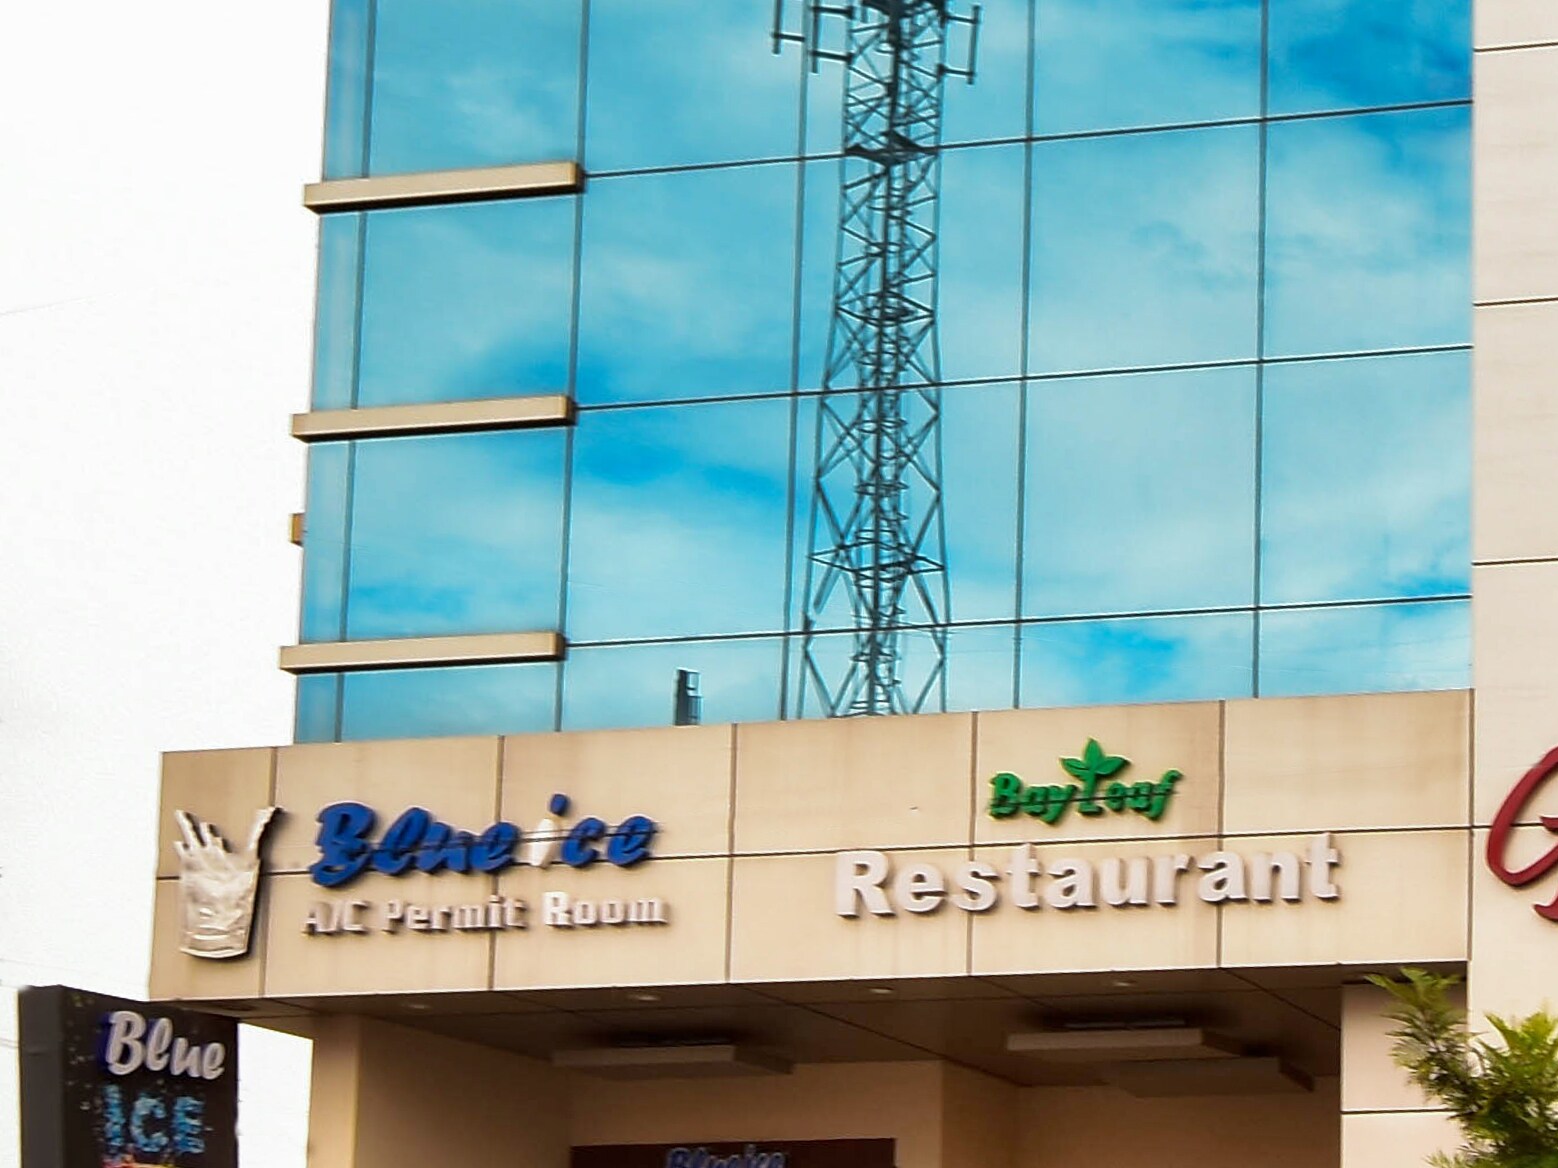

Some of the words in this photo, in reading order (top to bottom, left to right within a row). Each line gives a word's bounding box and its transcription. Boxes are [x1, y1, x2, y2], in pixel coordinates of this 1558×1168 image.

[987, 771, 1076, 824] Bay
[1076, 755, 1184, 821] Leaf
[309, 800, 519, 888] Blue
[834, 833, 1342, 918] Restaurant
[302, 901, 370, 936] A/C
[381, 895, 528, 934] Permit
[542, 889, 669, 929] Room
[103, 1010, 226, 1081] Blue
[101, 1085, 206, 1153] ICE
